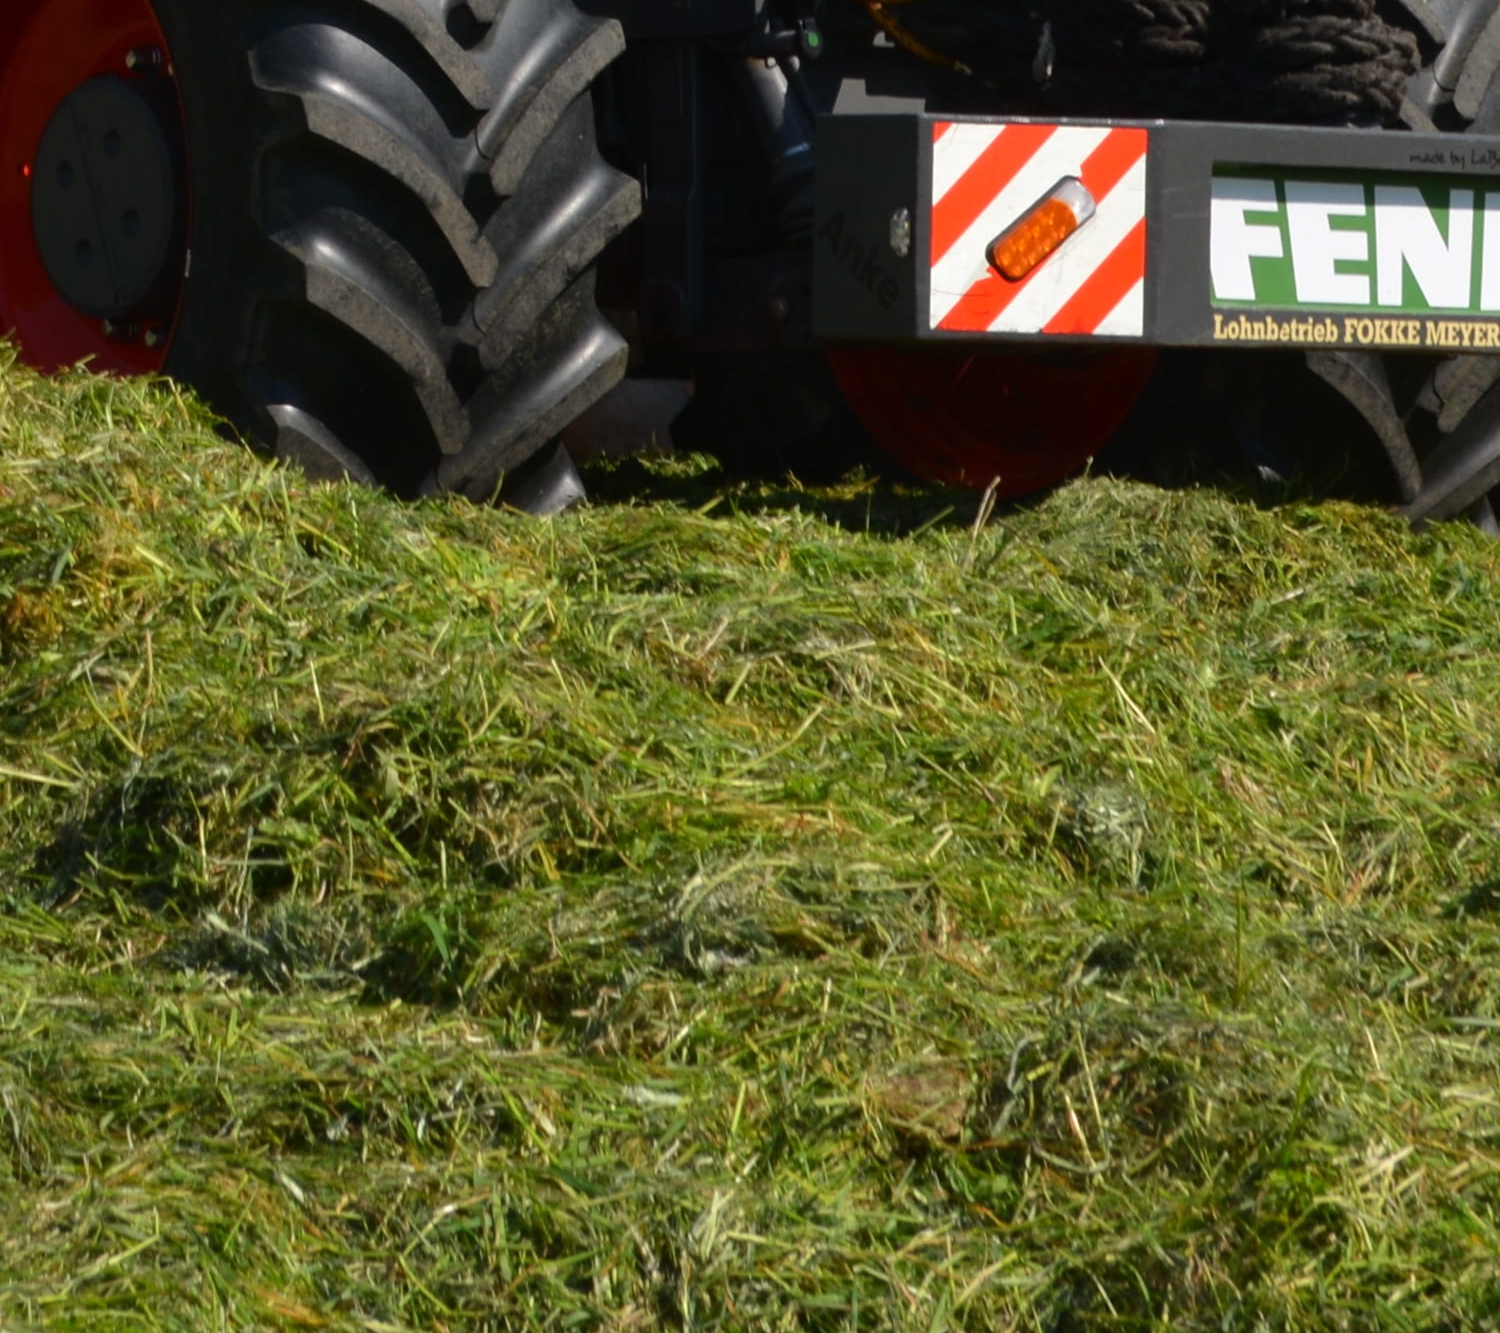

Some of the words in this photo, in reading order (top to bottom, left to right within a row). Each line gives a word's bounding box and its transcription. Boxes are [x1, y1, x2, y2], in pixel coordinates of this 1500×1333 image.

[1450, 149, 1466, 169] by
[1213, 314, 1339, 343] Lohnbetrieb
[1344, 319, 1420, 345] FOKKE
[1425, 322, 1500, 348] MEYER
